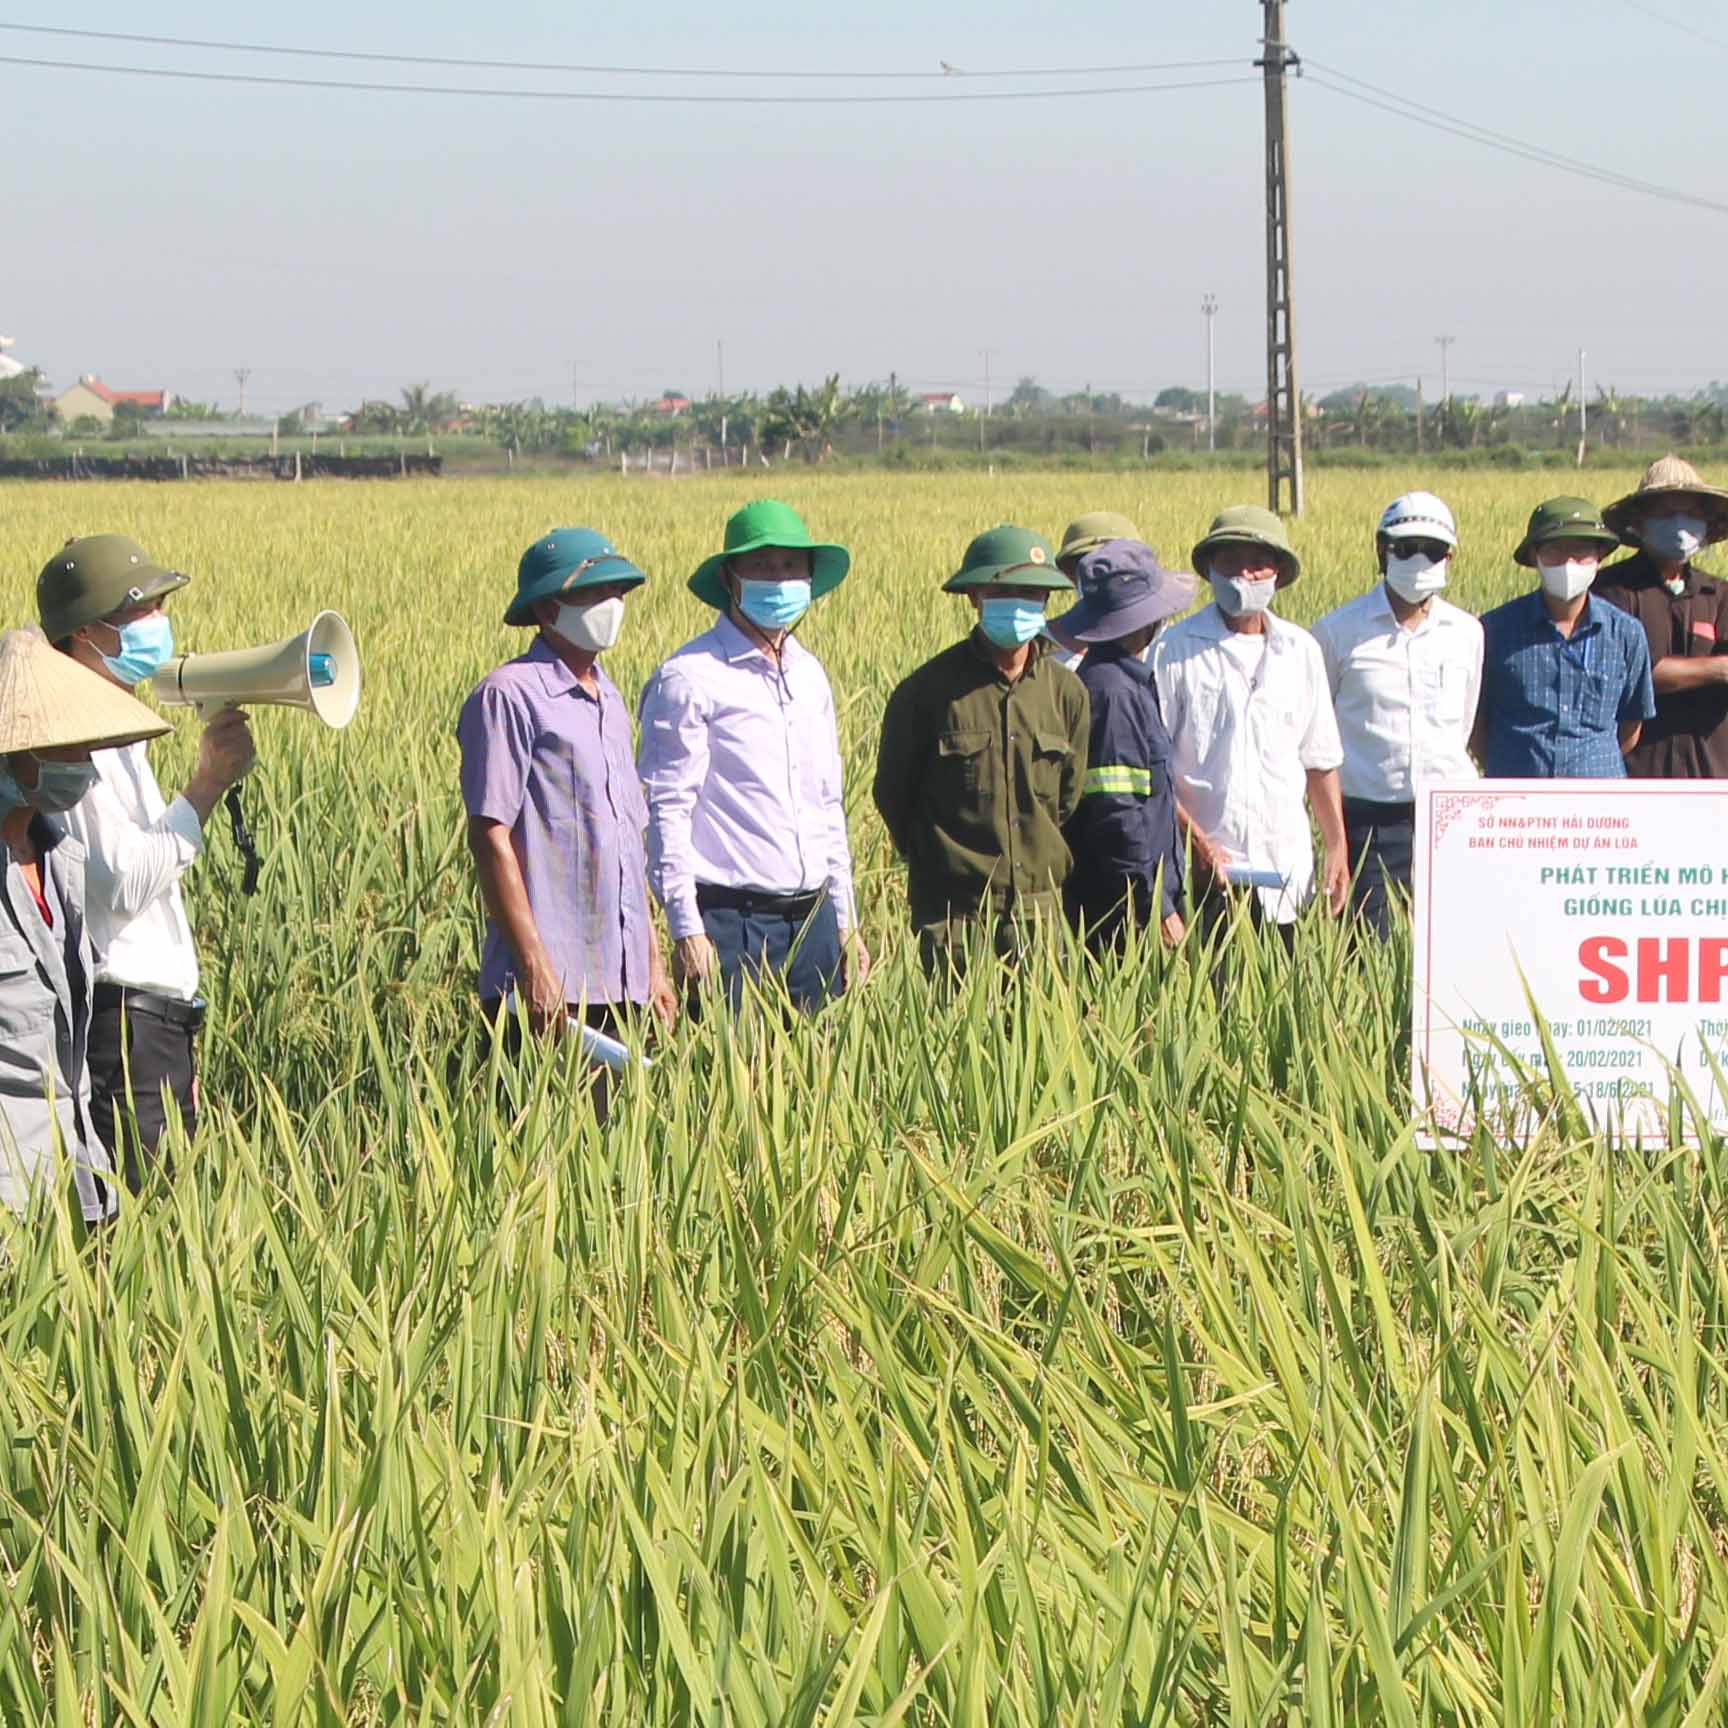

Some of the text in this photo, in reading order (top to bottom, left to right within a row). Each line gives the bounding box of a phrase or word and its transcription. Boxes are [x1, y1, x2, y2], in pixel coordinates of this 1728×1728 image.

[1499, 817, 1558, 829] NN&PTNT
[1587, 816, 1630, 829] DƯƠNG
[1469, 837, 1494, 849] BAN
[1528, 834, 1569, 851] NHIỆM
[1593, 834, 1611, 849] ÁN
[1540, 862, 1598, 885] PHÁT
[1606, 859, 1670, 885] TRIỂN
[1678, 863, 1714, 885] MÔ
[1564, 892, 1633, 916] GIỐNG
[1641, 894, 1683, 916] LÚA
[1501, 1018, 1531, 1038] gieo
[1576, 1018, 1652, 1037] 01/02/2021
[1567, 1049, 1642, 1067] 20/02/2021
